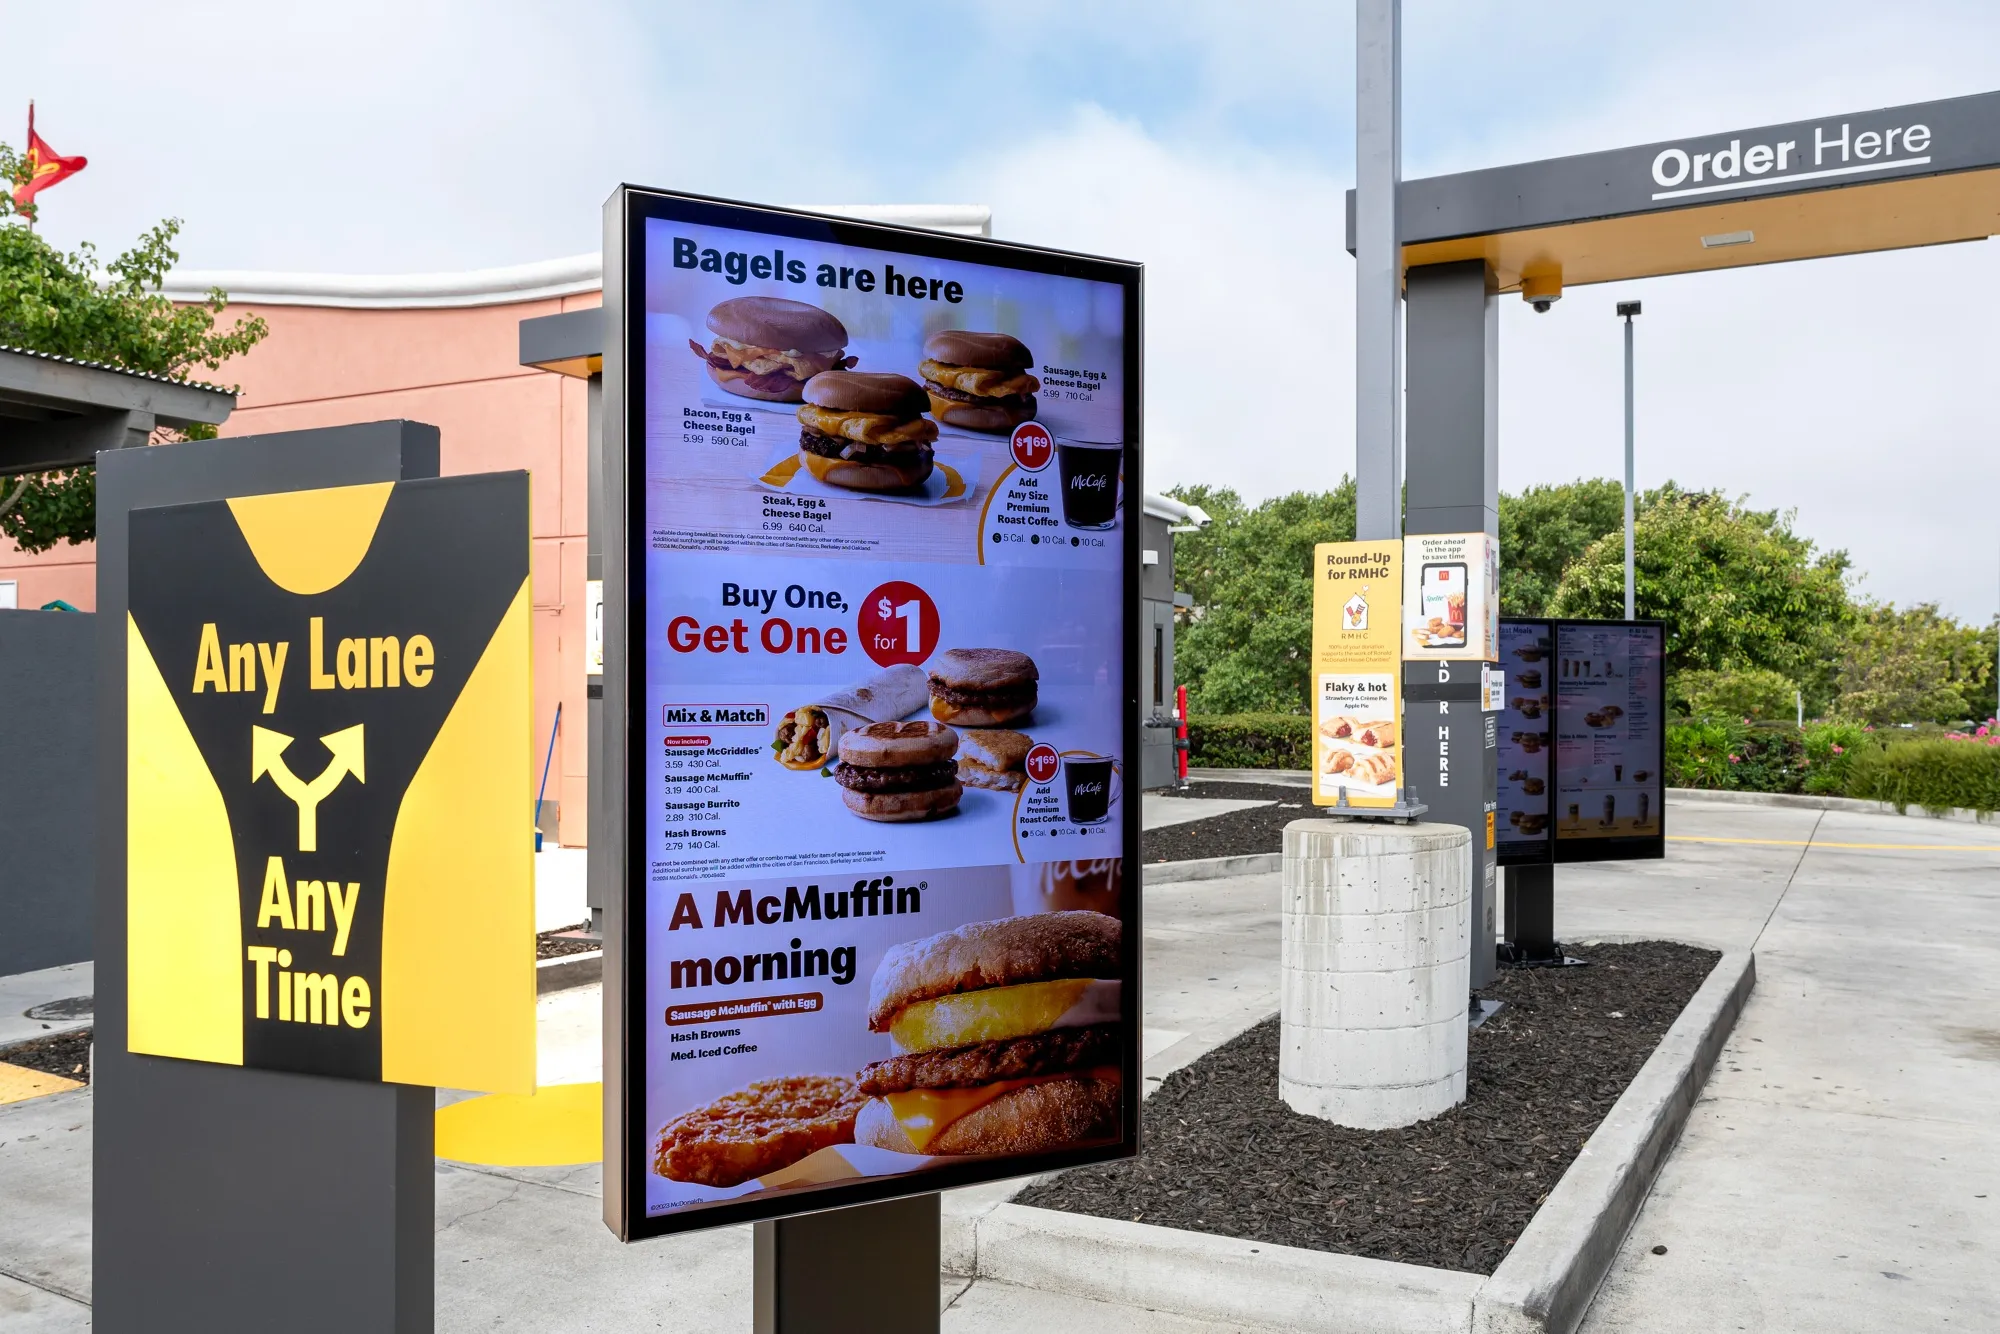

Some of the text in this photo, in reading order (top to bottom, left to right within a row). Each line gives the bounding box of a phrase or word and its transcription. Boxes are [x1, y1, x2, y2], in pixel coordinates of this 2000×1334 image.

[1651, 124, 1931, 187] Order Here
[673, 236, 963, 304] Bagels are here
[1043, 365, 1107, 381] Sausage, Egg &
[1043, 377, 1101, 391] Cheese Bagel
[1043, 389, 1094, 401] 5.99 710 Cal.
[683, 408, 752, 423] Bacon, Egg &
[683, 421, 755, 436] Cheese Bagel
[683, 433, 748, 447] 5.99 590 Cal.
[1018, 477, 1038, 487] Add
[1071, 473, 1106, 491] McCafé
[762, 496, 826, 509] Steak, Egg &
[1007, 490, 1049, 501] Any Size
[1006, 502, 1050, 513] Premium
[762, 508, 831, 522] Cheese Bagel
[997, 514, 1059, 526] Roast Coffee
[762, 521, 825, 533] 6.99 640 Cal.
[1010, 534, 1026, 543] Cal.
[1052, 536, 1067, 545] Cal.
[1091, 538, 1106, 548] Cal.
[1443, 538, 1466, 546] ahead
[1326, 552, 1391, 566] Round-Up
[1448, 552, 1466, 560] time
[1327, 567, 1390, 580] for RMHC
[722, 582, 848, 614] Buy One,
[877, 596, 921, 654] $1
[667, 615, 847, 654] Get One
[873, 633, 897, 650] for
[192, 616, 434, 714] Any Lane
[1325, 682, 1387, 695] Flaky & hot
[666, 707, 765, 722] Mix & Match
[680, 737, 709, 747] including
[664, 748, 705, 758] Sausage
[1438, 726, 1450, 787] HERE
[664, 759, 721, 769] 3.59 430 Cal.
[664, 774, 705, 784] Sausage
[664, 785, 720, 794] 3.19 400 Cal.
[1036, 787, 1050, 795] Add
[665, 799, 740, 811] Sausage Burrito
[1027, 796, 1059, 806] Any Size
[665, 812, 720, 822] 2.89 310 Cal.
[1027, 806, 1060, 814] Premium
[1020, 815, 1066, 824] Roast Coffee
[665, 829, 726, 838] Hash Browns
[665, 840, 720, 851] 2.79 140 Cal.
[257, 856, 360, 957] Any
[668, 892, 703, 931] A
[670, 937, 856, 989] morning
[247, 945, 371, 1028] Time
[670, 1008, 717, 1020] Sausage
[772, 998, 796, 1010] with
[797, 998, 816, 1009] Egg
[670, 1028, 740, 1042] Hash Browns
[670, 1043, 757, 1061] Med. Iced Coffee
